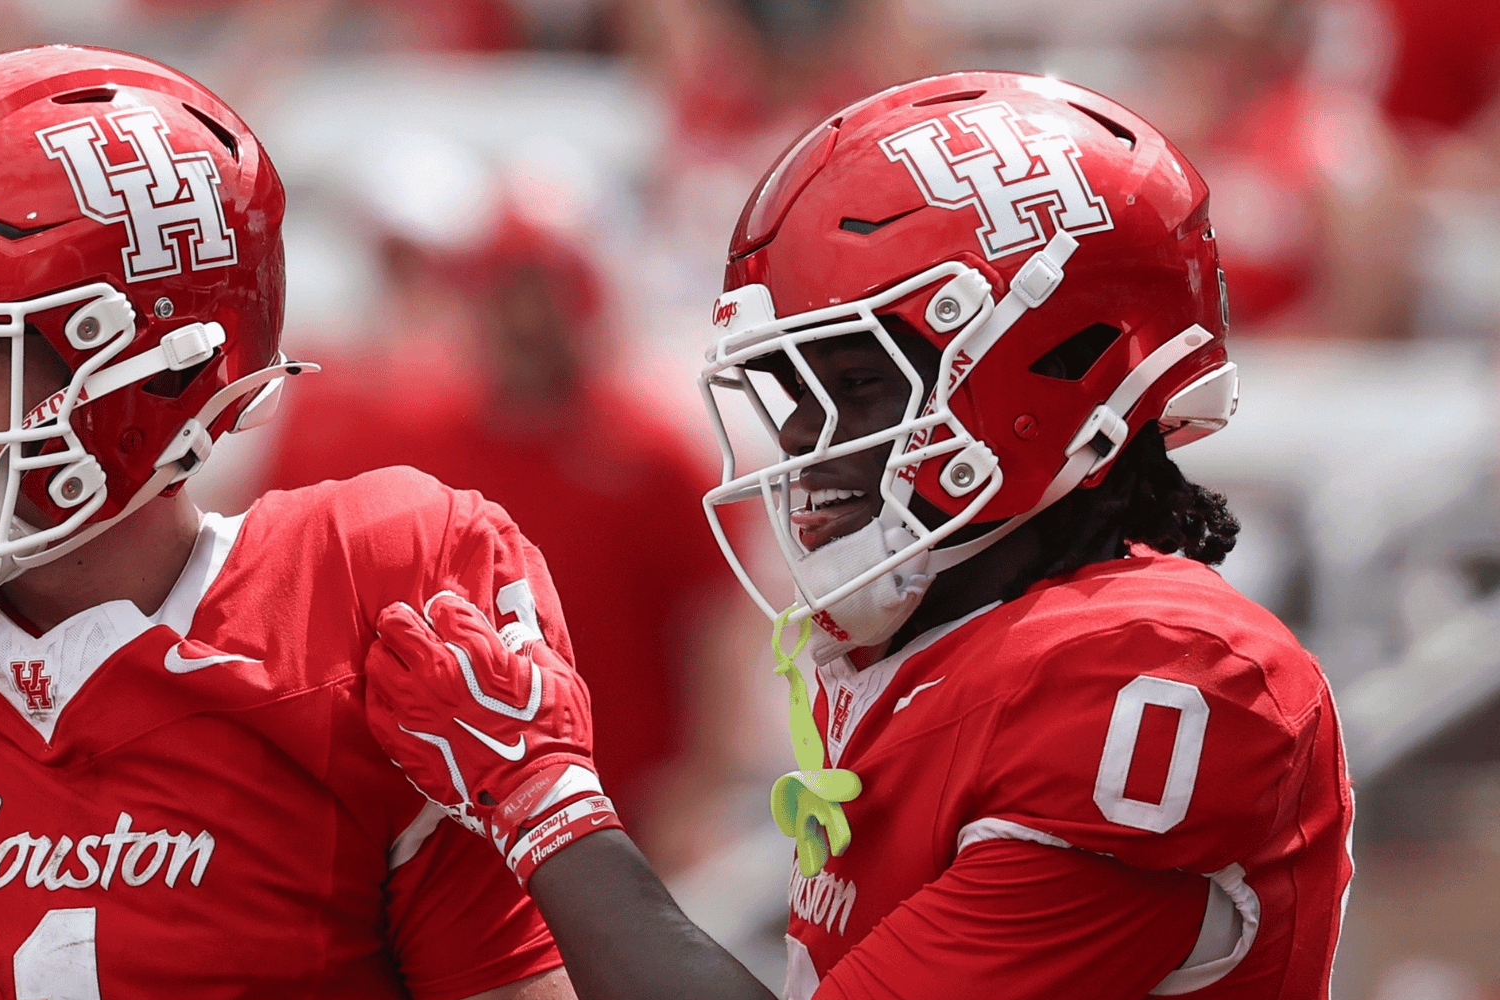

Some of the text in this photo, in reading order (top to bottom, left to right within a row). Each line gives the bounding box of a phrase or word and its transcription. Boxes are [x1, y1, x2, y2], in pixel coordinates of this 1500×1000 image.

[35, 106, 238, 283] UH
[877, 100, 1114, 261] UH
[9, 657, 53, 711] UH
[1092, 674, 1211, 834] 0
[528, 811, 570, 843] Houston
[531, 832, 573, 865] Houston
